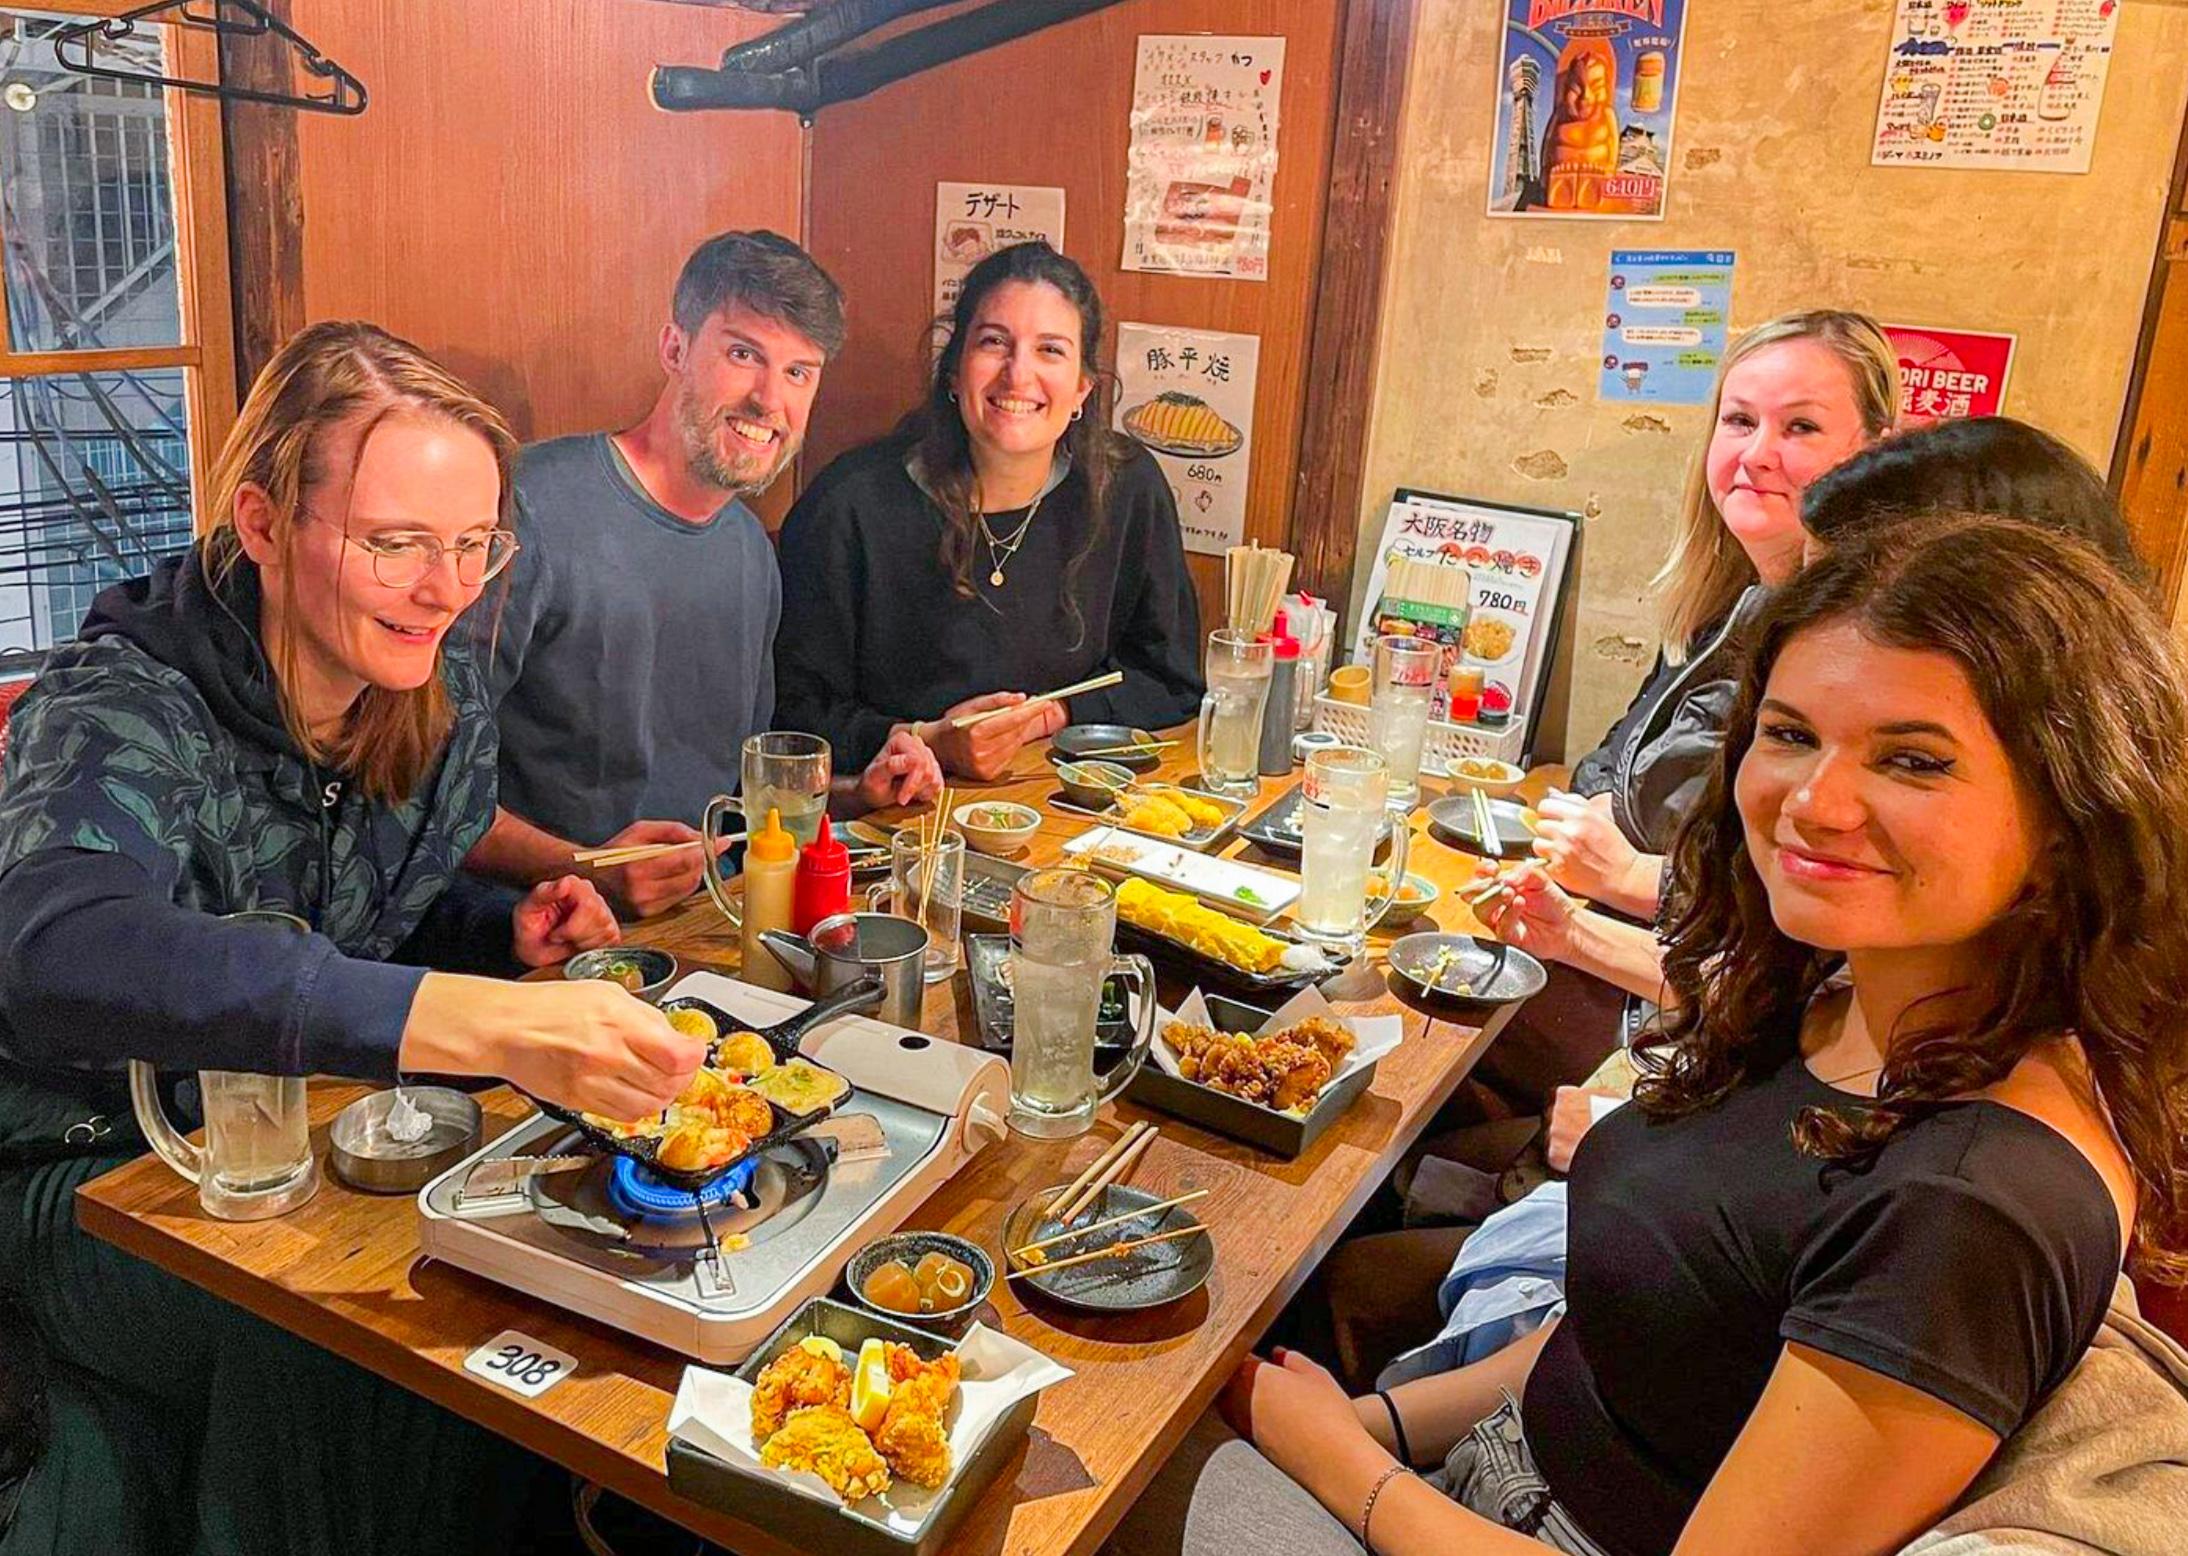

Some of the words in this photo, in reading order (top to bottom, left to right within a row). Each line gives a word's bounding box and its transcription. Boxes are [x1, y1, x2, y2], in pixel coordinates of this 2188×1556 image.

[965, 191, 1021, 220] デザート
[1900, 367, 1930, 388] ORI
[1932, 370, 1989, 394] BEER
[1402, 512, 1496, 544] 大阪名物
[1479, 589, 1528, 612] 780円
[486, 1344, 561, 1385] 308
